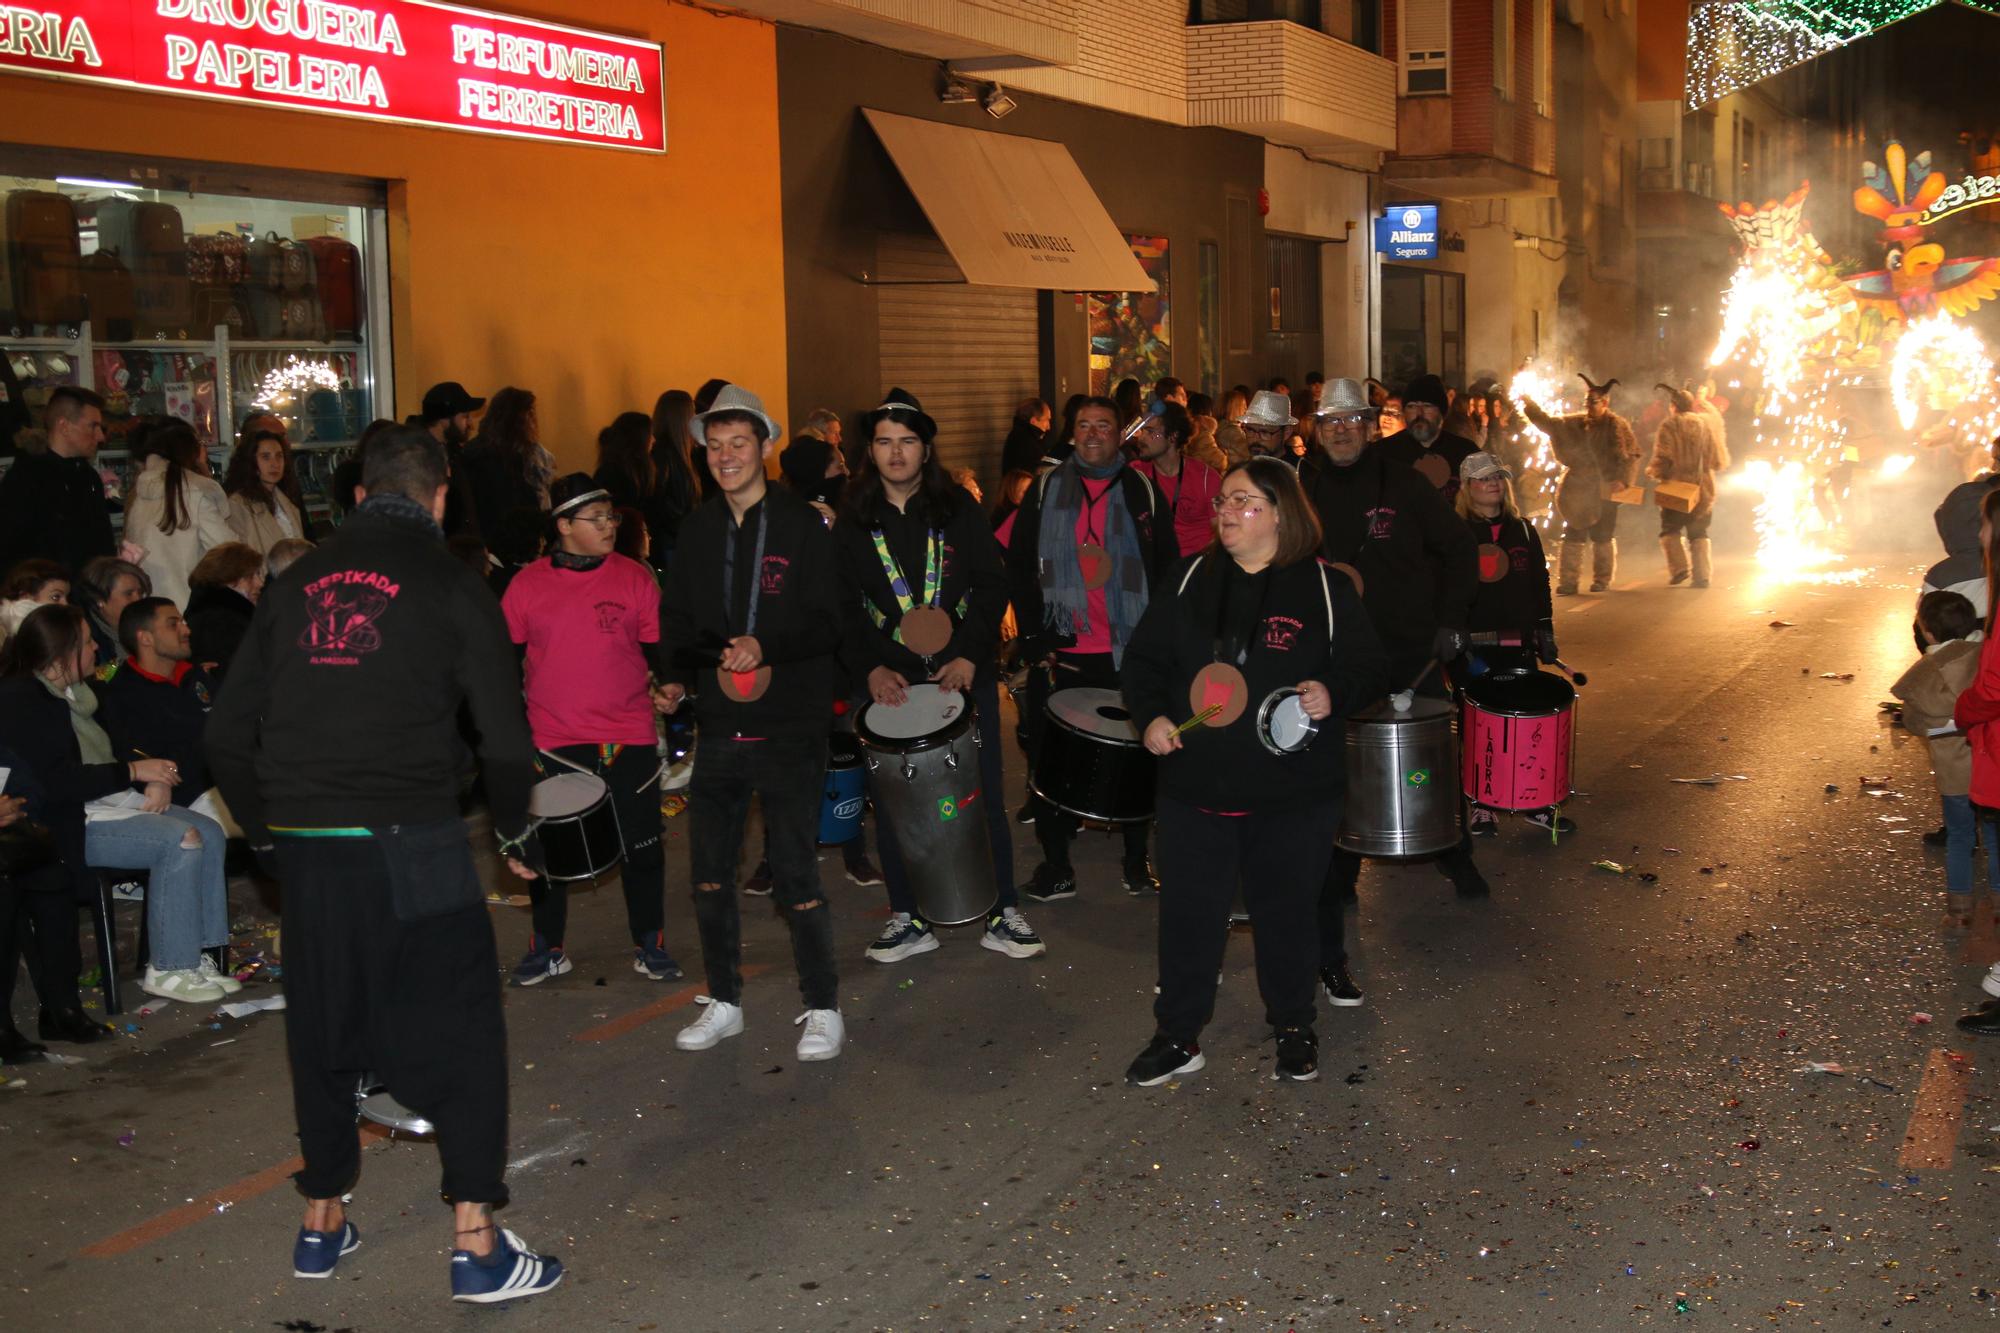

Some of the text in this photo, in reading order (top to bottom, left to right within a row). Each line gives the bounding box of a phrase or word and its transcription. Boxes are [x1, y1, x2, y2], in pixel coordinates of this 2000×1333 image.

[165, 34, 390, 108] PAPELERIA
[451, 24, 645, 94] PERFUMERIA
[457, 78, 643, 141] FERRETERIA
[1390, 230, 1435, 243] Allianz
[1395, 247, 1428, 258] Seguros
[304, 571, 400, 598] REPIKADA
[1484, 726, 1494, 797] LAURA
